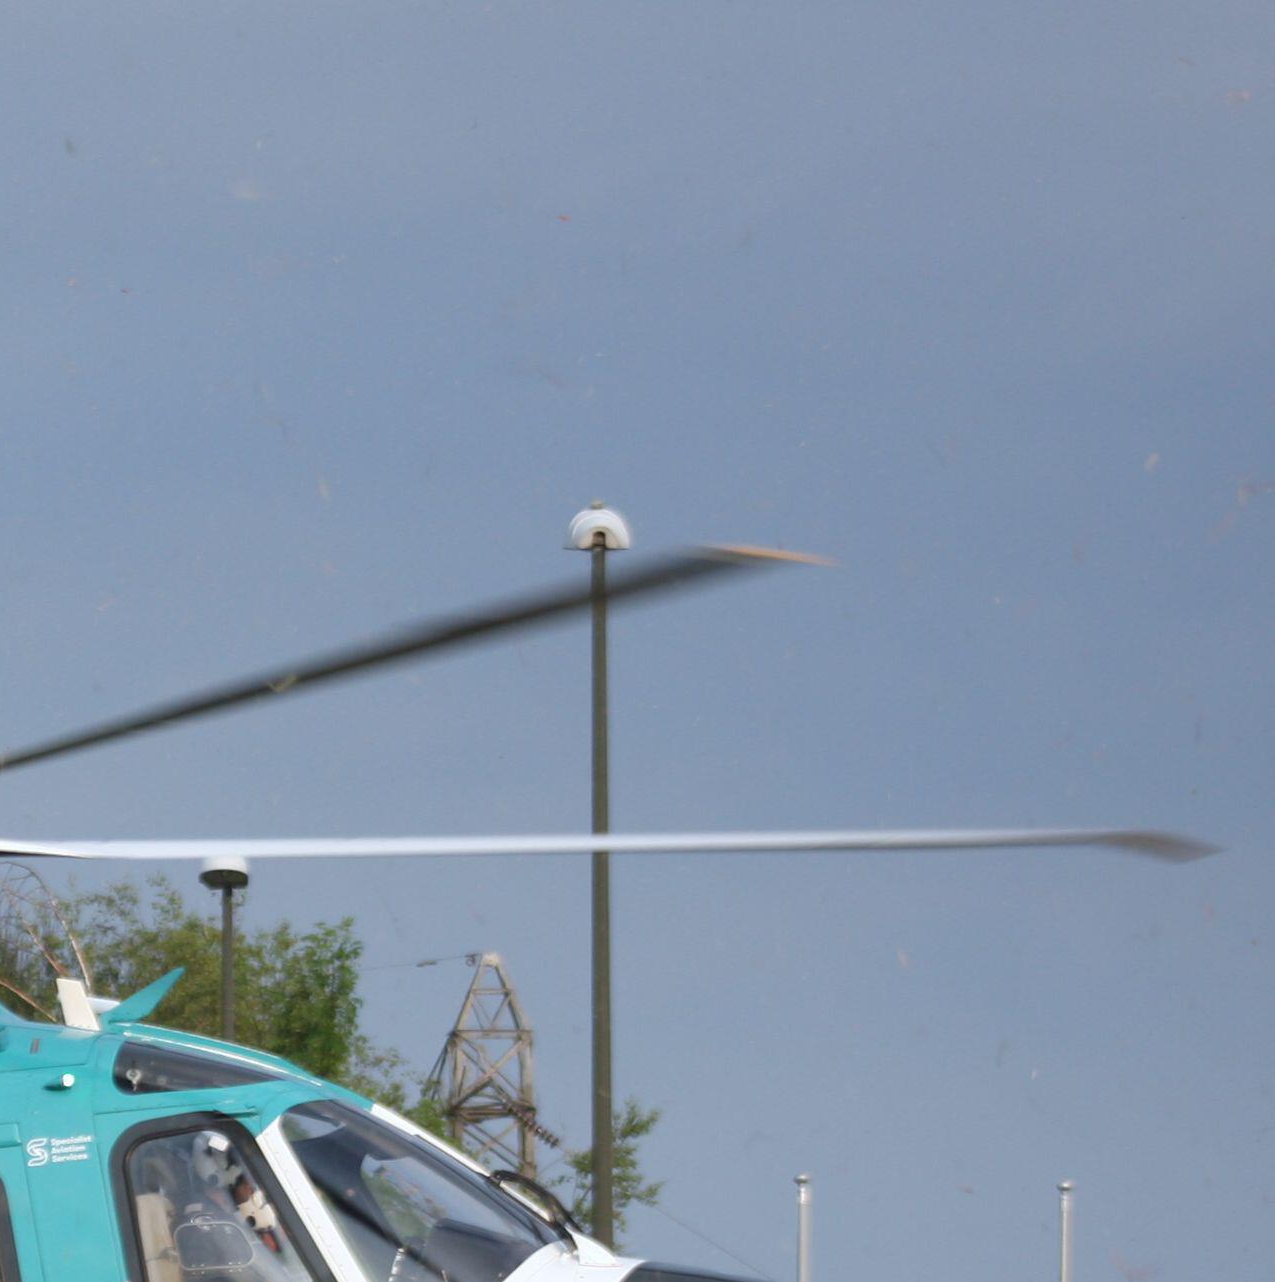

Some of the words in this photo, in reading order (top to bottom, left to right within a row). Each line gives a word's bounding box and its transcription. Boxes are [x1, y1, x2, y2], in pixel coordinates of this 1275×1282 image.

[50, 1135, 92, 1146] Specialist
[50, 1145, 86, 1154] Aviation
[51, 1153, 88, 1162] Services
